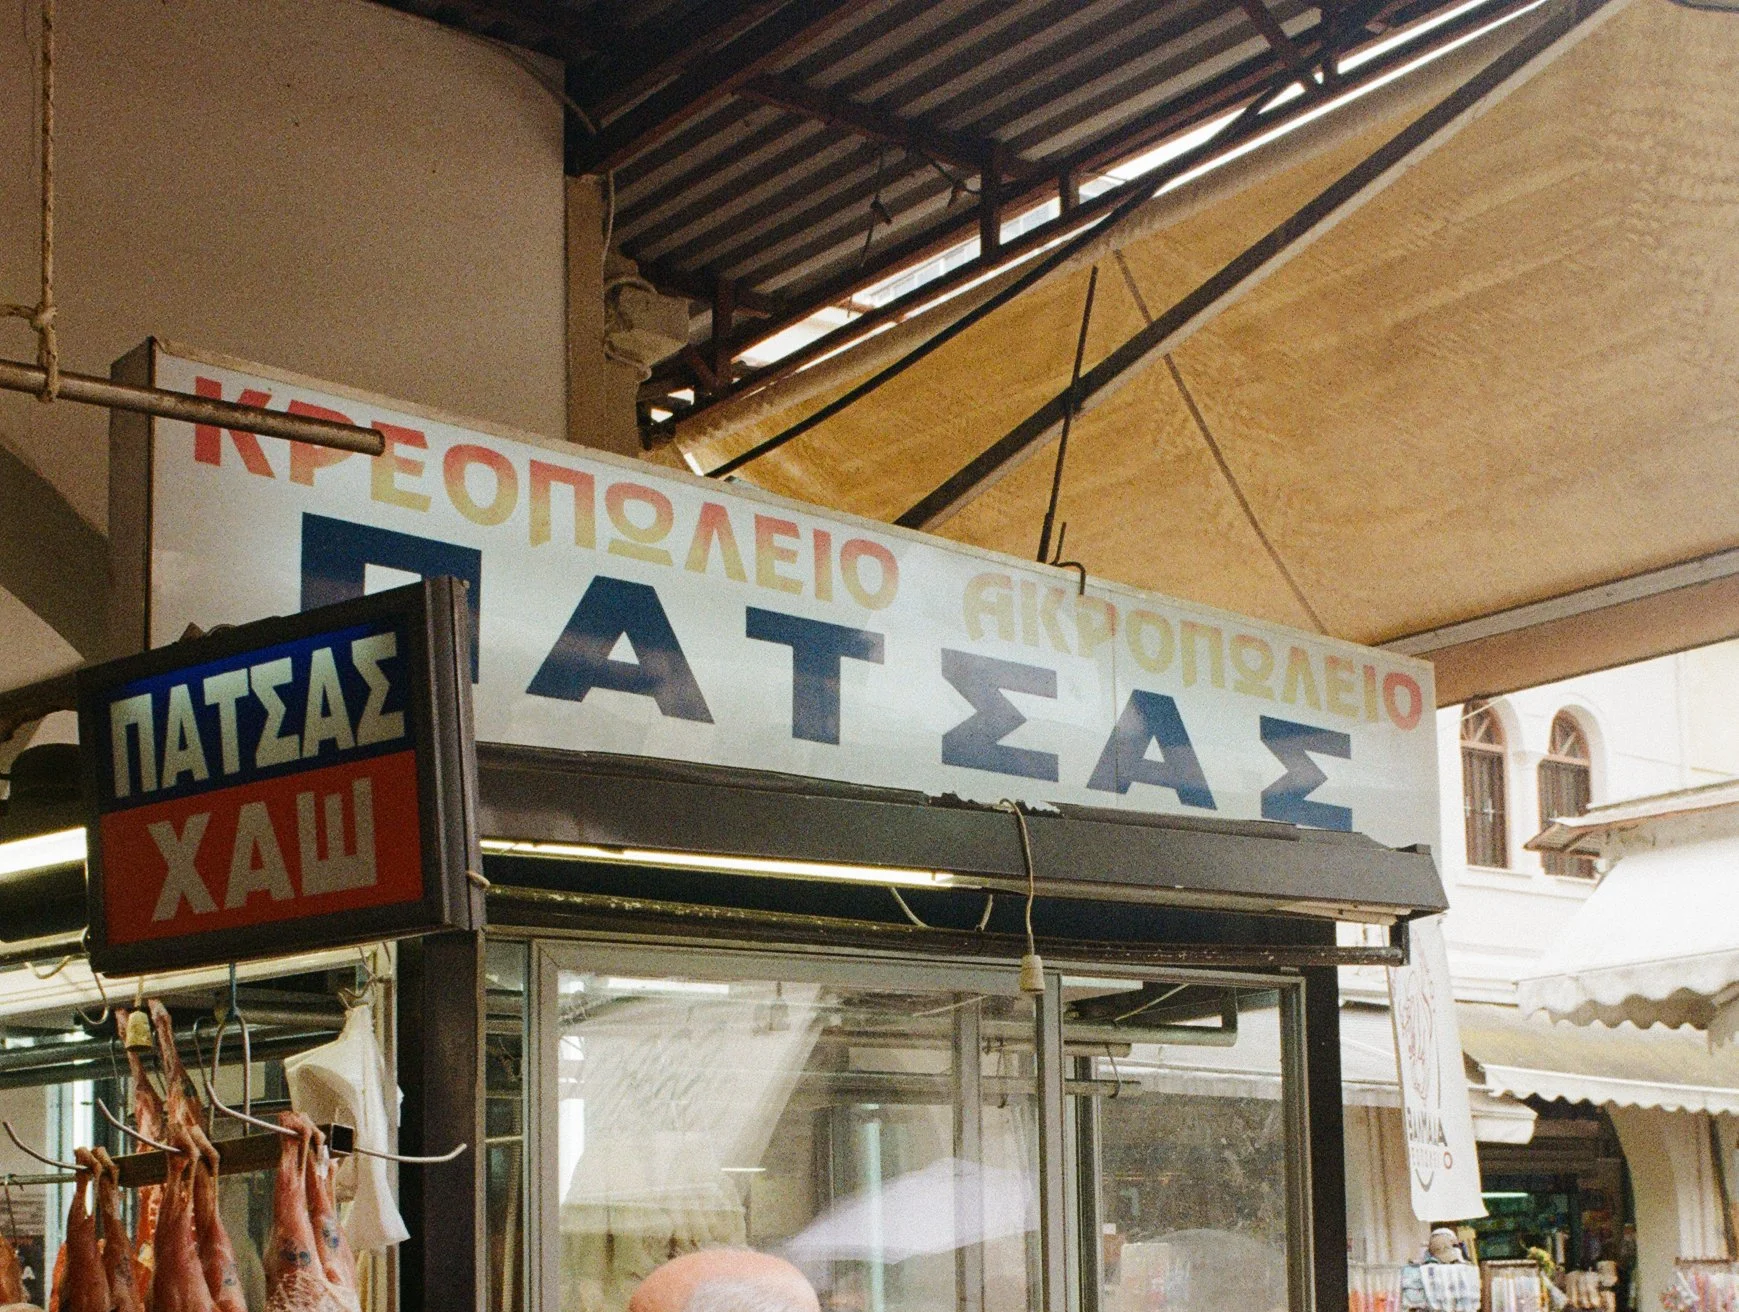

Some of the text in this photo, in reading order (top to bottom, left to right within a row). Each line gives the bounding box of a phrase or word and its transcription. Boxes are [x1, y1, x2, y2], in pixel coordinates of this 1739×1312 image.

[194, 375, 899, 611] ΚΡΕΟΠΩΛΕΙΟ
[110, 631, 405, 798] ΠΑΤΣΑΣ
[147, 777, 378, 923] ХАШ
